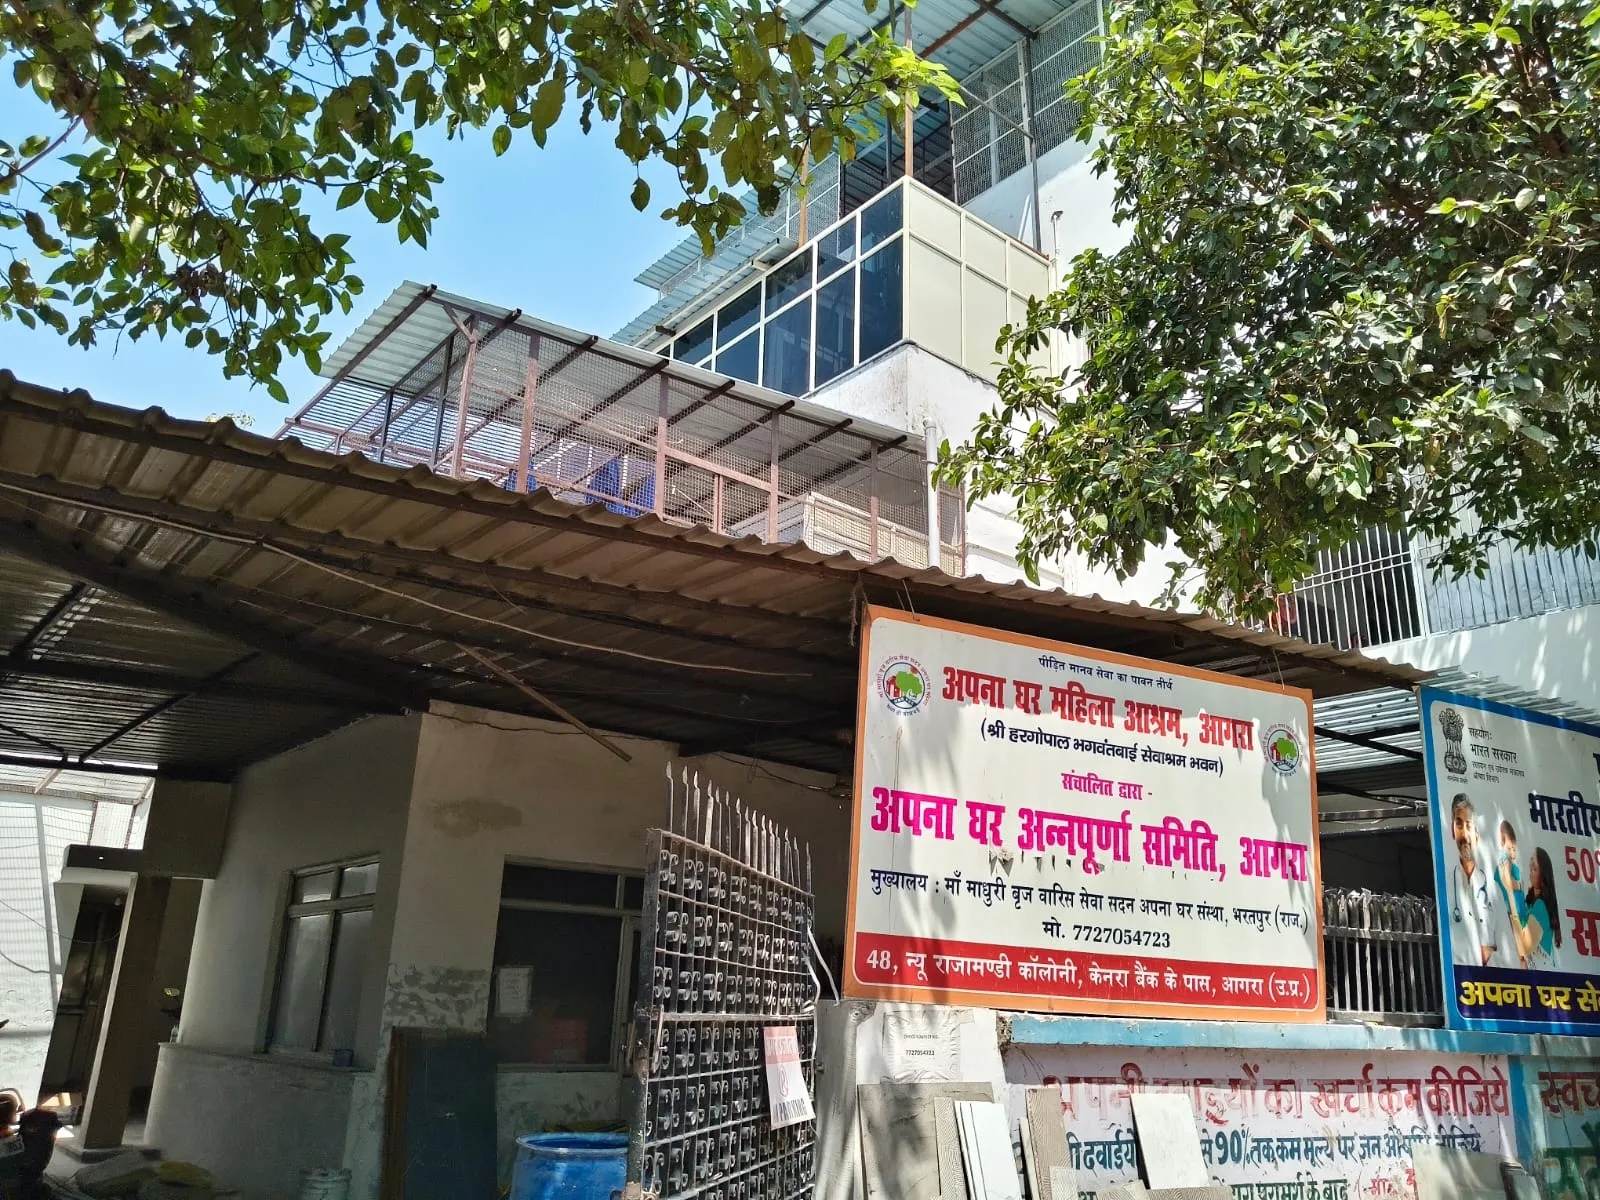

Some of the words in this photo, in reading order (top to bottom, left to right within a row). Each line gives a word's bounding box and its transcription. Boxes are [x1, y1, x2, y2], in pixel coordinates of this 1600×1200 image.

[1038, 655, 1065, 672] पीड़ित
[1069, 663, 1093, 676] मानव
[1096, 666, 1113, 680] सेवा
[1117, 672, 1127, 683] का
[1131, 675, 1153, 687] पावन
[1156, 676, 1173, 690] तीर्थ
[942, 666, 1006, 709] अपना
[1013, 680, 1042, 714] घर
[1049, 680, 1116, 728] महिला
[1124, 700, 1189, 747] आश्रम,
[1199, 713, 1254, 751] आगरा
[981, 717, 1005, 741] (श्री
[1009, 726, 1070, 749] हरगोपाल
[1074, 738, 1138, 762] भगवंतबाई
[1141, 746, 1186, 768] सेवाश्रम
[1190, 756, 1224, 778] भवन)
[1470, 743, 1490, 758] भारत
[1491, 747, 1518, 764] सरकार
[1061, 769, 1113, 797] संचालित
[1119, 782, 1143, 800] द्वारा
[871, 786, 957, 841] अपना
[966, 800, 1006, 847] घर
[1018, 807, 1132, 875] अन्नपूर्णा
[1141, 815, 1226, 882] समिति,
[1239, 836, 1308, 882] आगरा
[871, 869, 928, 895] मुख्यालय
[944, 871, 961, 896] माँ
[966, 877, 1006, 907] माधुरी
[1011, 885, 1033, 909] बृज
[1038, 882, 1075, 910] वारिस
[1080, 887, 1103, 911] सेवा
[1108, 895, 1135, 914] सदन
[1140, 898, 1172, 918] अपना
[1176, 902, 1193, 920] घर
[1197, 900, 1228, 927] संस्था,
[1232, 907, 1271, 932] भरतपुर
[1274, 903, 1308, 935] (राज.)
[1042, 916, 1065, 939] मो.
[1073, 924, 1171, 949] 7727054723
[866, 949, 898, 976] 48,
[905, 951, 928, 981] न्यू
[933, 952, 1012, 980] राजामण्डी
[1018, 954, 1083, 989] कॉलोनी,
[1089, 961, 1129, 988] केनरा
[1134, 960, 1159, 989] बैंक
[1164, 967, 1178, 990] के
[1183, 974, 1217, 998] पास,
[1222, 976, 1264, 996] आगरा
[1268, 972, 1310, 1003] (उ.प्र.)
[1460, 981, 1531, 1008] अपना
[1536, 985, 1572, 1011] घर
[1263, 1078, 1303, 1119] का
[1377, 1078, 1421, 1117] कम
[1425, 1065, 1510, 1117] कीजिये
